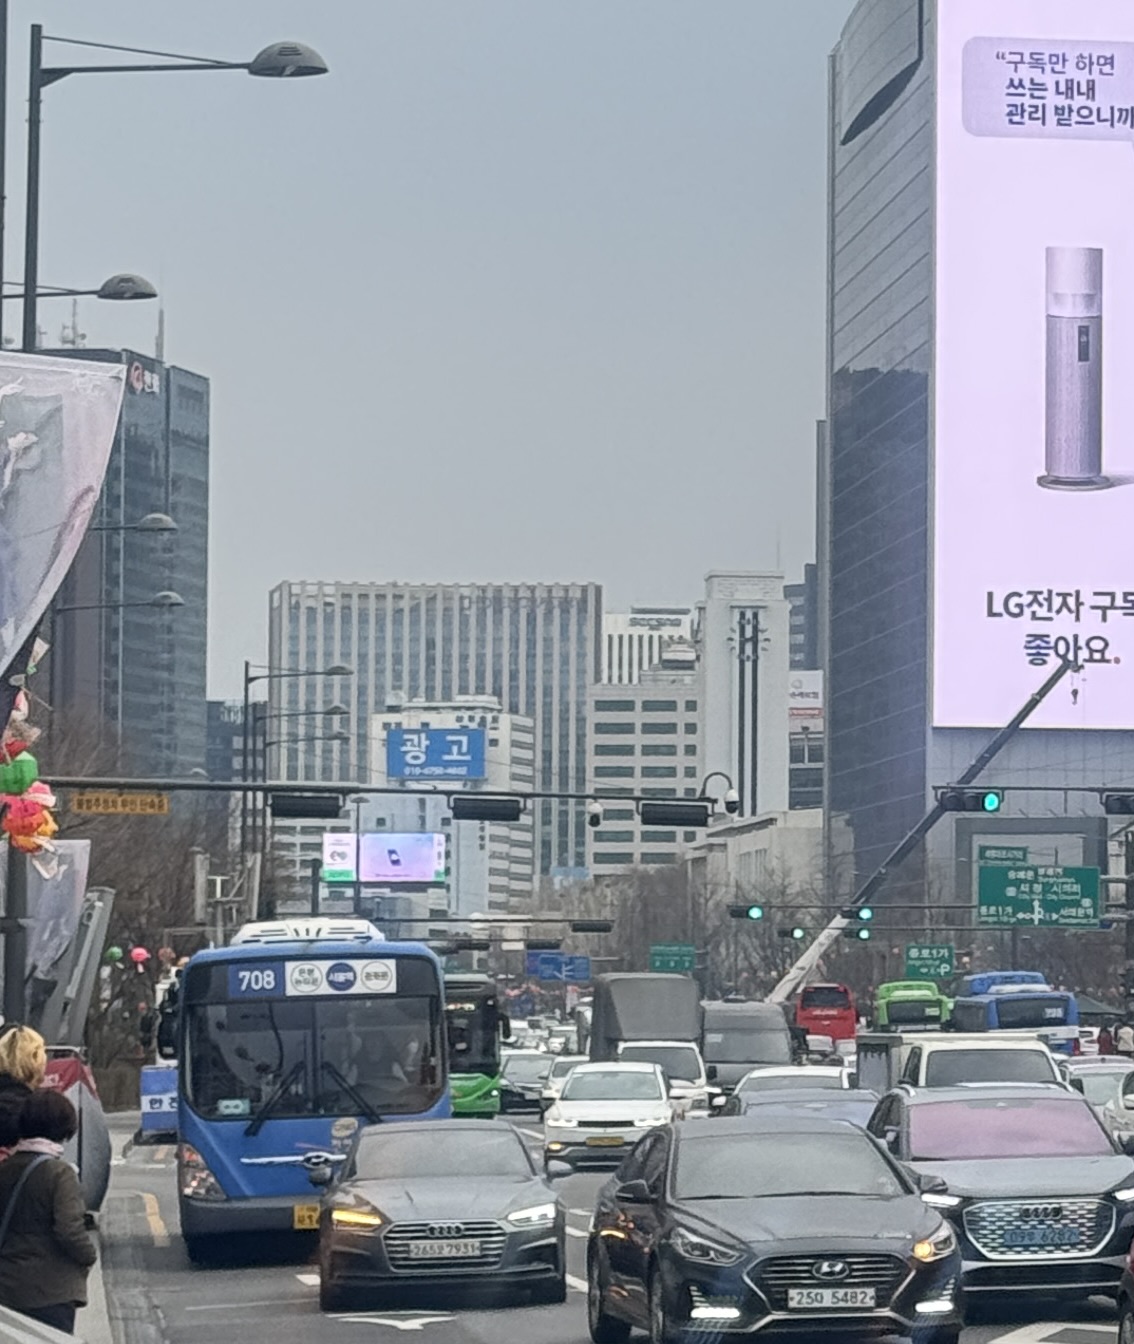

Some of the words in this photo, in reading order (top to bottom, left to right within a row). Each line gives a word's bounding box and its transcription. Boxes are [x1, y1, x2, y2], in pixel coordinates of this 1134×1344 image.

[1075, 53, 1115, 76] 하면
[1005, 77, 1048, 100] 쓰는
[1055, 79, 1096, 102] 내내
[1005, 103, 1047, 126] 관리
[986, 588, 1085, 623] LG전자
[1023, 633, 1121, 667] 좋아요.
[400, 733, 472, 765] 광고
[908, 948, 949, 958] 종로1가
[238, 969, 276, 992] 708
[831, 1290, 869, 1305] 5482
